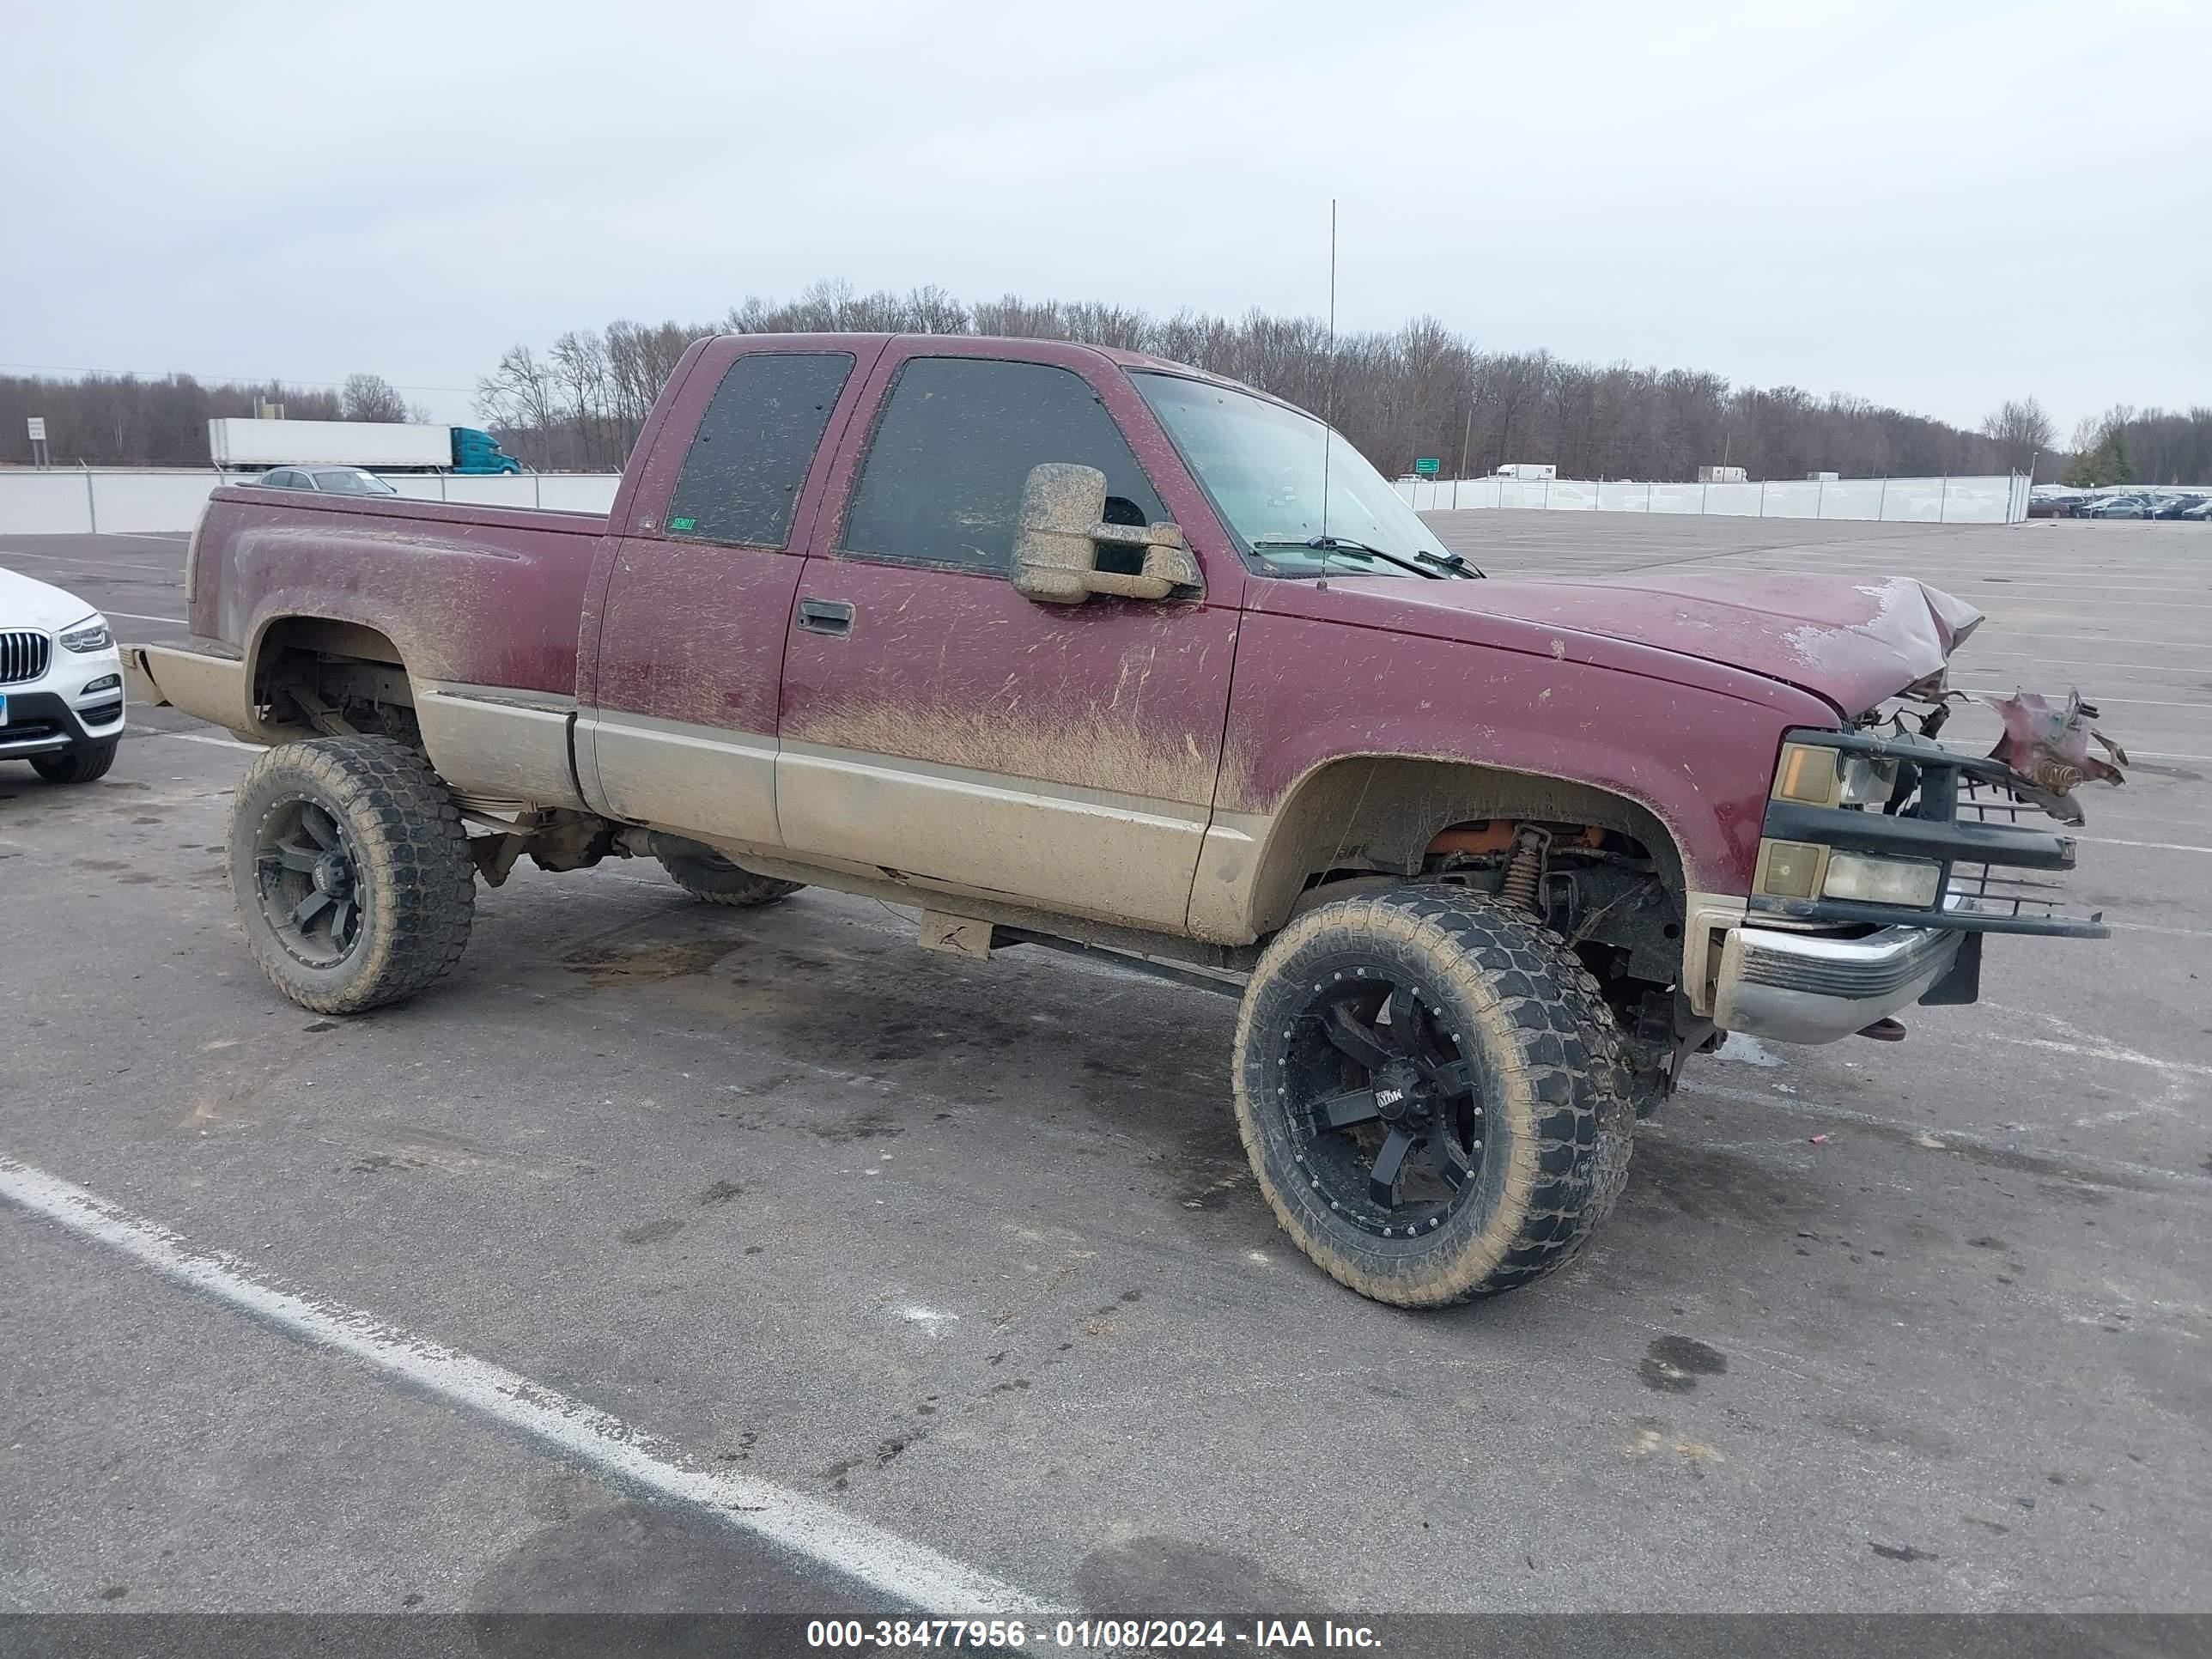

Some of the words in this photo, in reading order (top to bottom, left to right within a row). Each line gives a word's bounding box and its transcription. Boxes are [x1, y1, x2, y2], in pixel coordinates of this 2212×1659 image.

[673, 518, 690, 527] SEND
[688, 520, 696, 529] IT
[1377, 1089, 1404, 1108] MOTO
